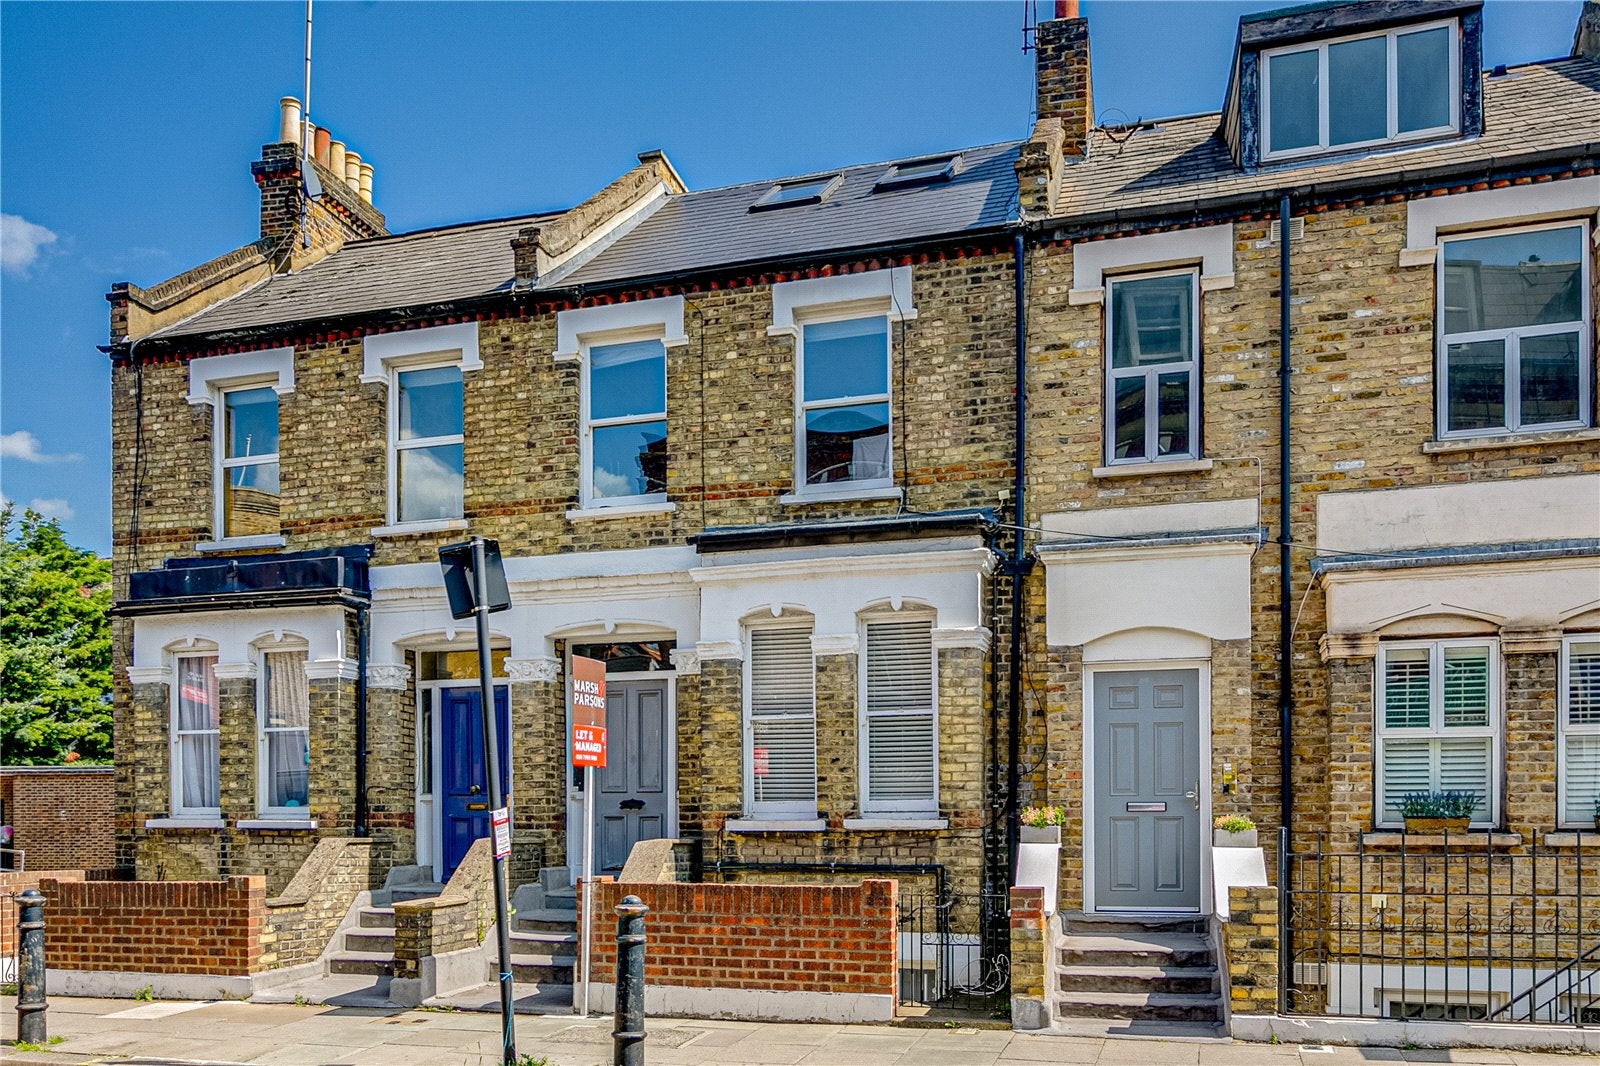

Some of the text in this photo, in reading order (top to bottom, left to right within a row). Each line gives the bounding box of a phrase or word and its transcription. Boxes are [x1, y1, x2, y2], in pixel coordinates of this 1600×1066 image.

[574, 680, 598, 694] MARSH
[574, 693, 605, 708] PARSONS
[575, 729, 588, 740] LET
